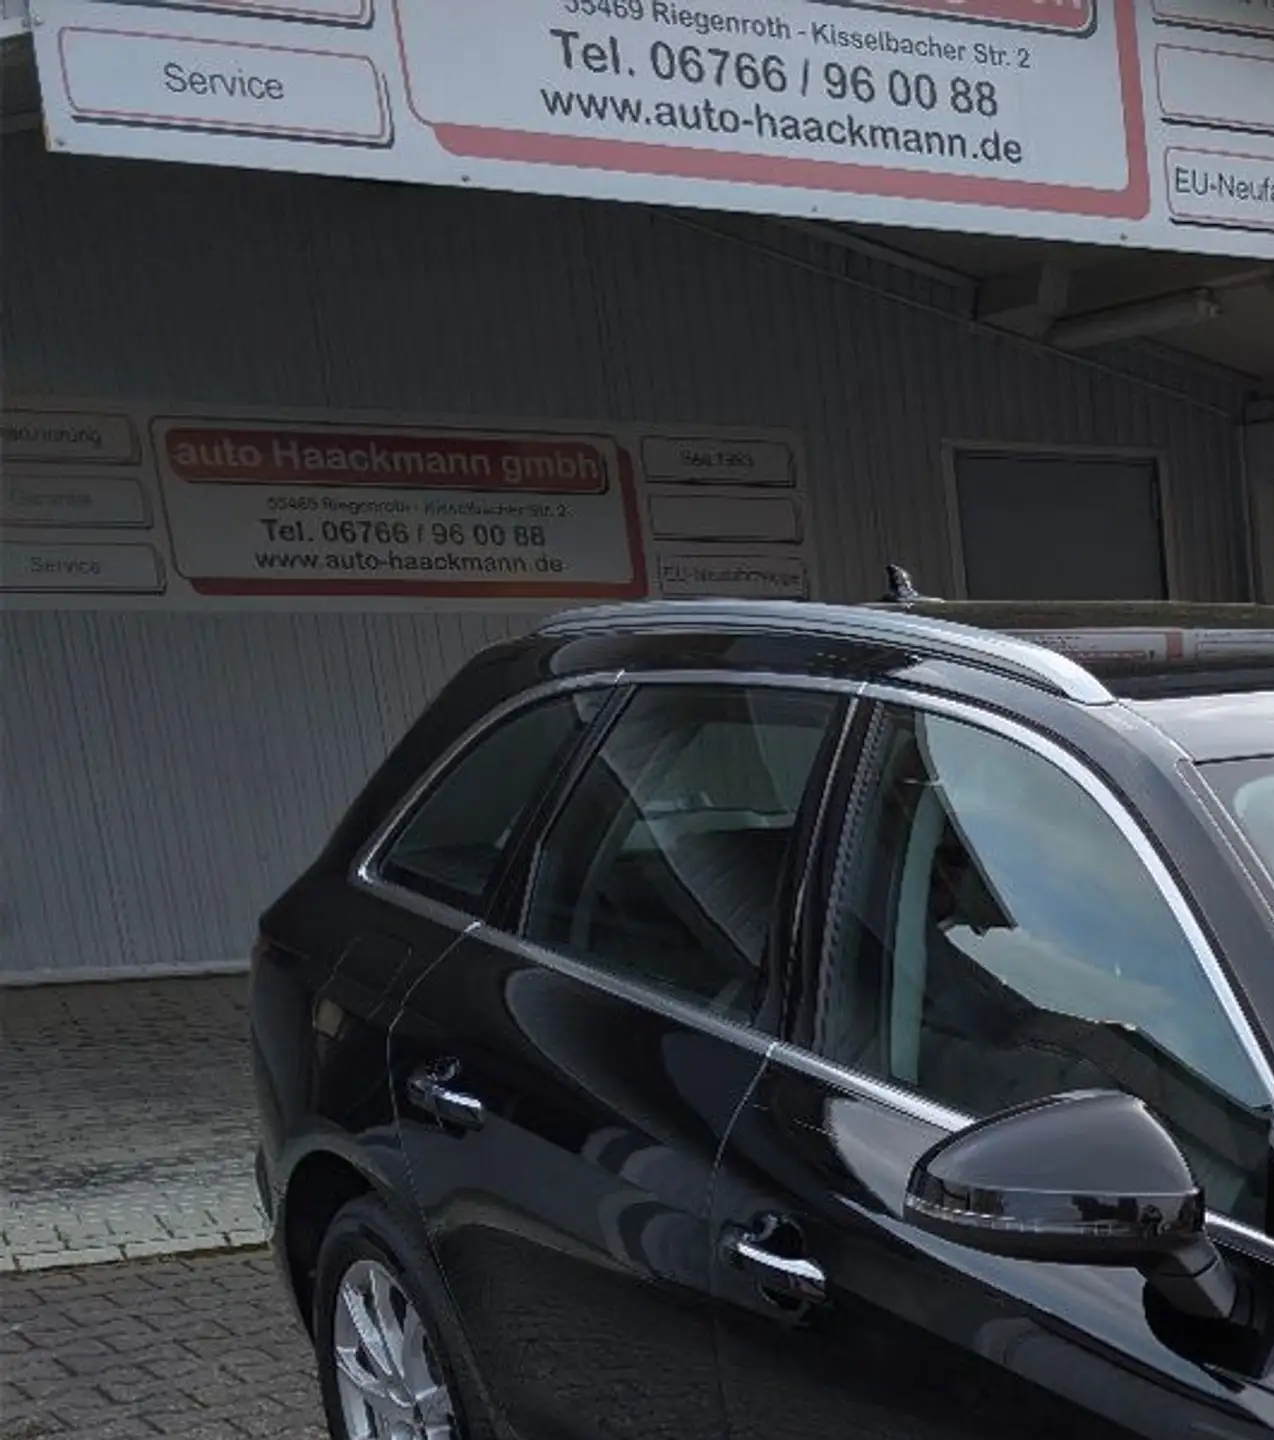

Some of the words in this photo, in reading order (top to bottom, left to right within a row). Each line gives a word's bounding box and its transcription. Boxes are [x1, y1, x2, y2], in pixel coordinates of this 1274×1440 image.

[652, 1, 791, 41] Riegenroth
[811, 21, 967, 62] Kisselbacher
[973, 43, 1011, 67] Str.
[1016, 47, 1031, 69] 2
[163, 62, 285, 101] Service
[549, 28, 636, 78] Tel.
[650, 40, 788, 93] 06766
[800, 57, 810, 97] /
[823, 62, 876, 104] 96
[888, 69, 937, 111] 00
[950, 76, 999, 118] 88
[540, 88, 1023, 164] www.auto-haackmann.de
[173, 436, 264, 469] auto
[270, 438, 492, 477] Haackmann
[500, 450, 600, 484] gmbh
[259, 519, 314, 543] Tel.
[321, 520, 410, 544] 06766
[431, 522, 465, 546] 96
[473, 523, 506, 547] 00
[513, 524, 546, 547] 88
[253, 549, 564, 574] www.auto-haackmann.de
